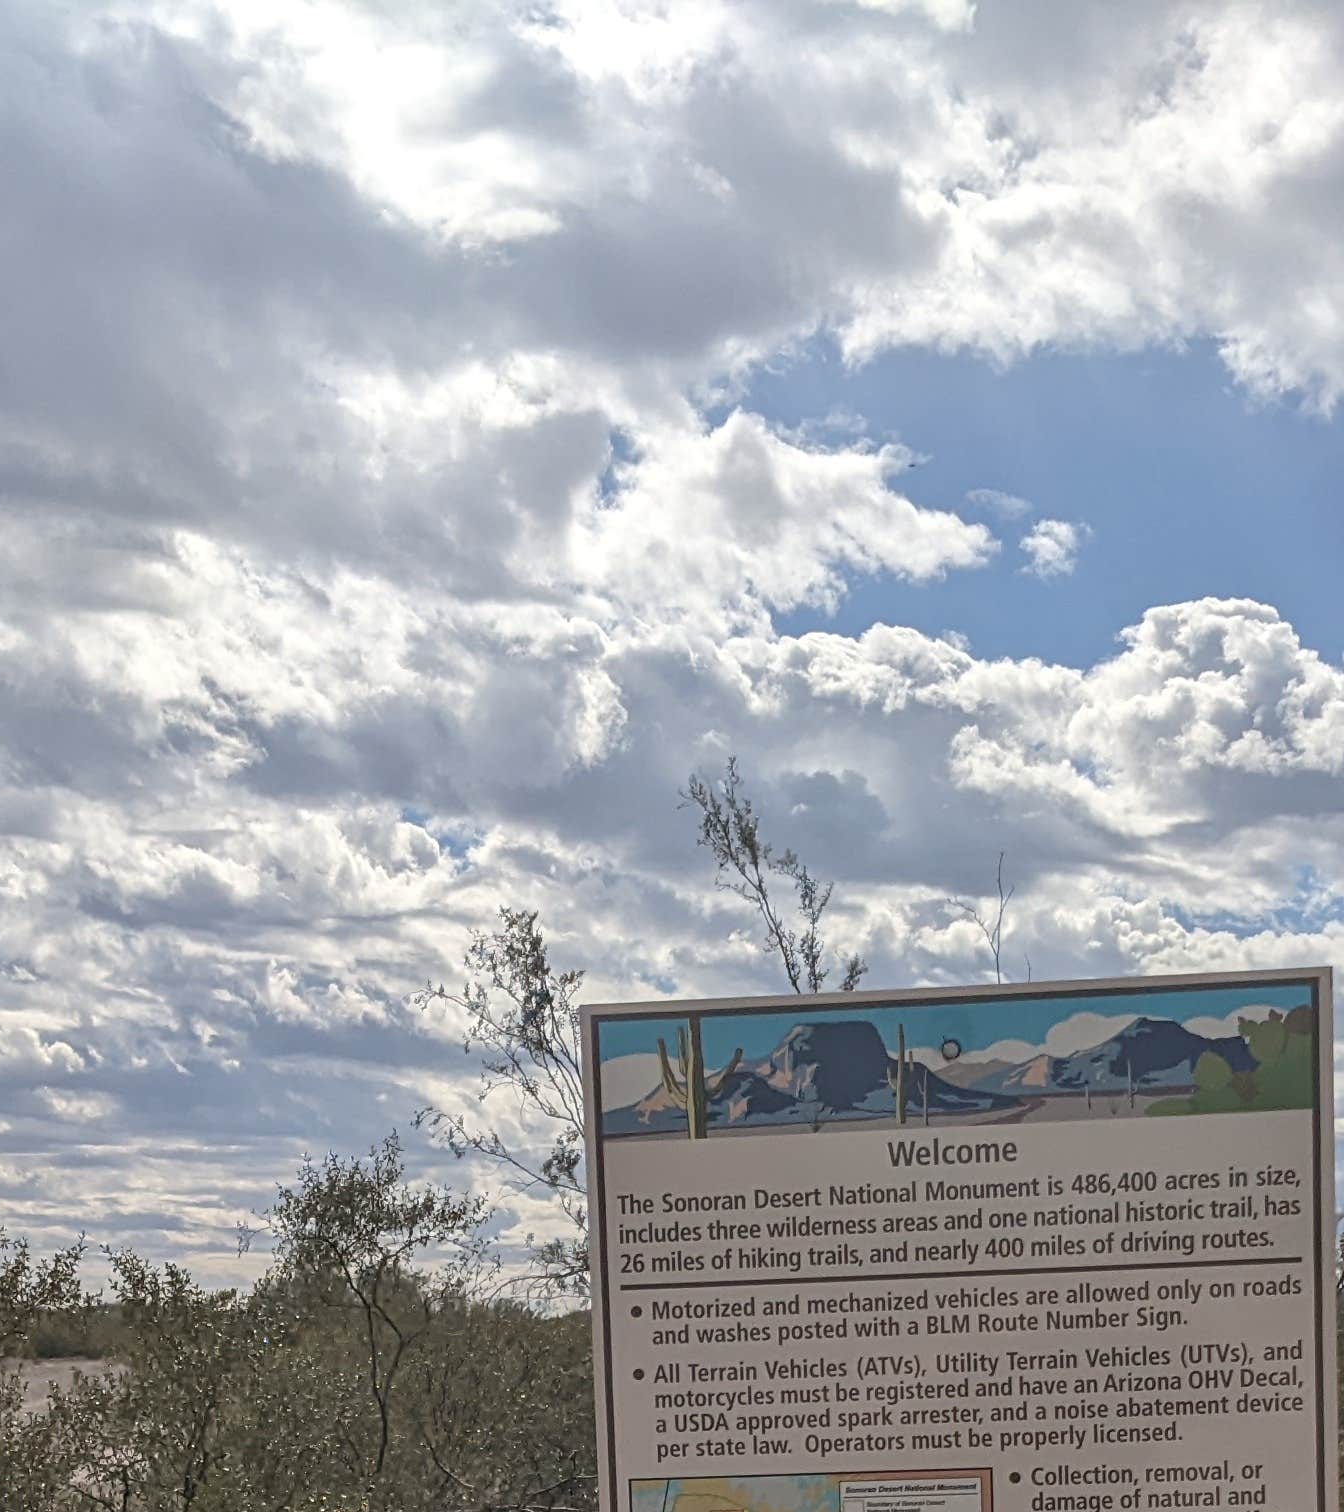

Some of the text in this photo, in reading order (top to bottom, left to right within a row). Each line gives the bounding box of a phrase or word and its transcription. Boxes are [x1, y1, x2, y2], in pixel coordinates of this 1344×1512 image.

[887, 1137, 1018, 1167] Welcome
[617, 1165, 1301, 1215] The Sonoran Desert National Monument is 486,400 acres in size,
[619, 1194, 1301, 1244] includes three wilderness areas and one national historic trail, has
[620, 1229, 1274, 1274] 26 miles of hiking trails, and nearly 400 miles of driving routes.
[652, 1274, 1302, 1320] Motorized and mechanized vehicles are allowed only on roads
[652, 1306, 1188, 1346] and washes posted with a BLM Route Number Sign.
[653, 1339, 1303, 1384] All Terrain Vehicles (ATVs), Utility Terrain Vehicles (UTVs), and
[655, 1365, 1304, 1412] motorcycles must be registered and have an Arizona OHV Decal,
[656, 1392, 1303, 1435] a USDA approved spark arrester, and a noise abatement device
[657, 1420, 1183, 1463] per state law. Operators must be properly licensed.
[1031, 1460, 1263, 1486] Collection, removal, or
[1120, 1488, 1142, 1509] of
[1147, 1485, 1220, 1508] natural
[1227, 1484, 1266, 1506] and
